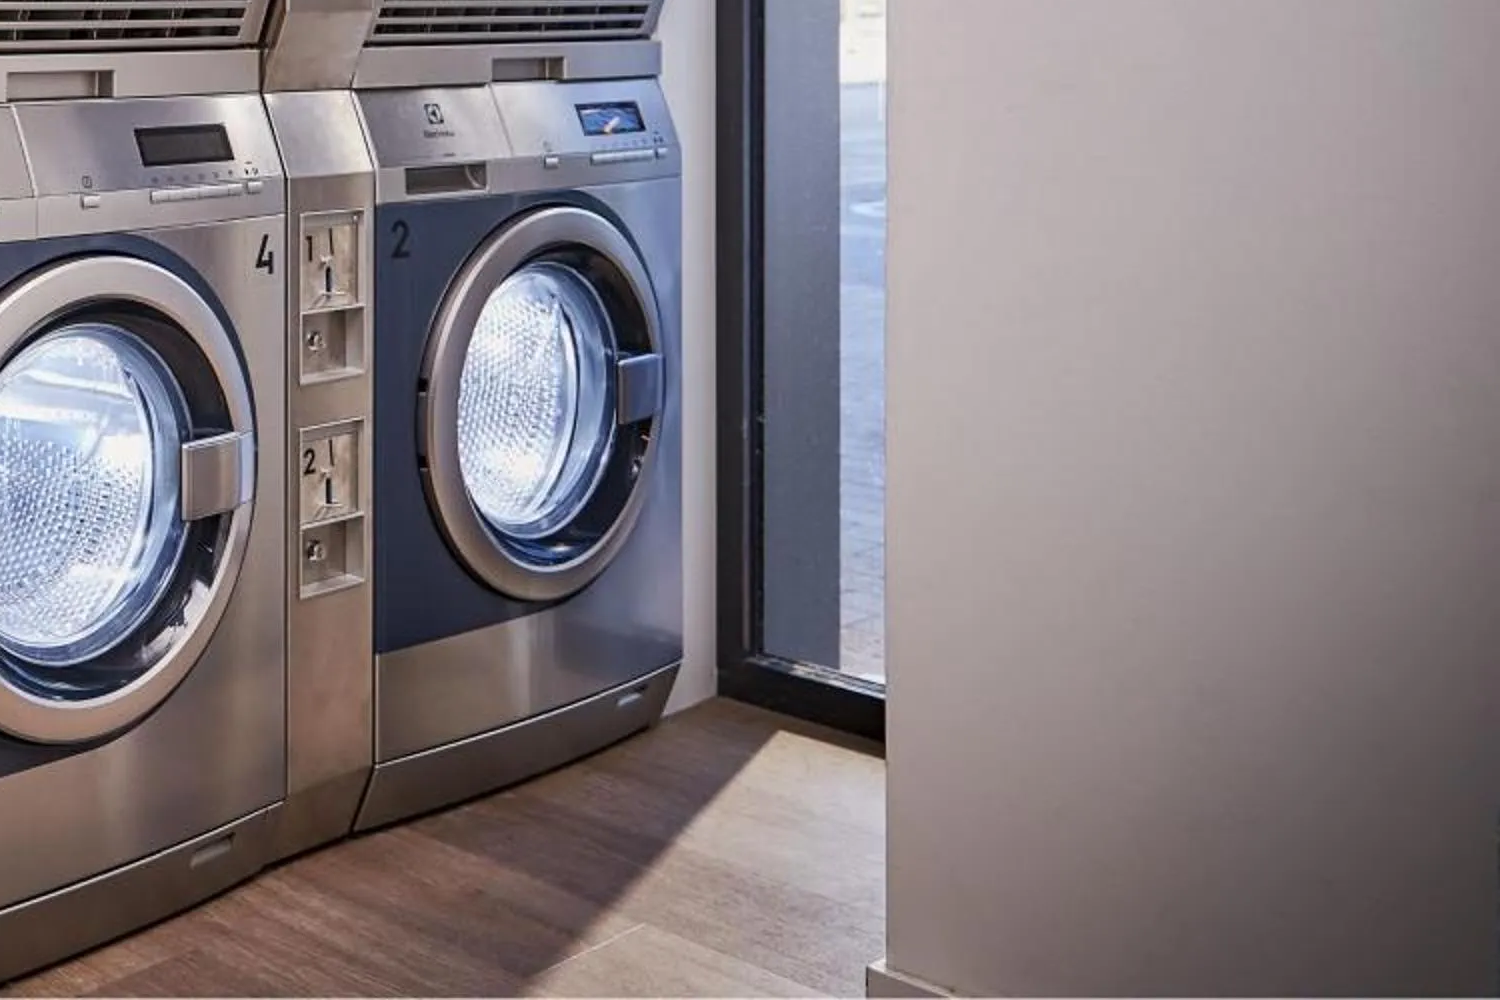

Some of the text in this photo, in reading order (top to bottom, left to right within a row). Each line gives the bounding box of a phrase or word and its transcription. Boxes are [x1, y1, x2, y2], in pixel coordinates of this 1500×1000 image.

[255, 233, 274, 275] 4
[305, 235, 313, 263] 1
[391, 219, 411, 259] 2
[303, 447, 316, 476] 2
